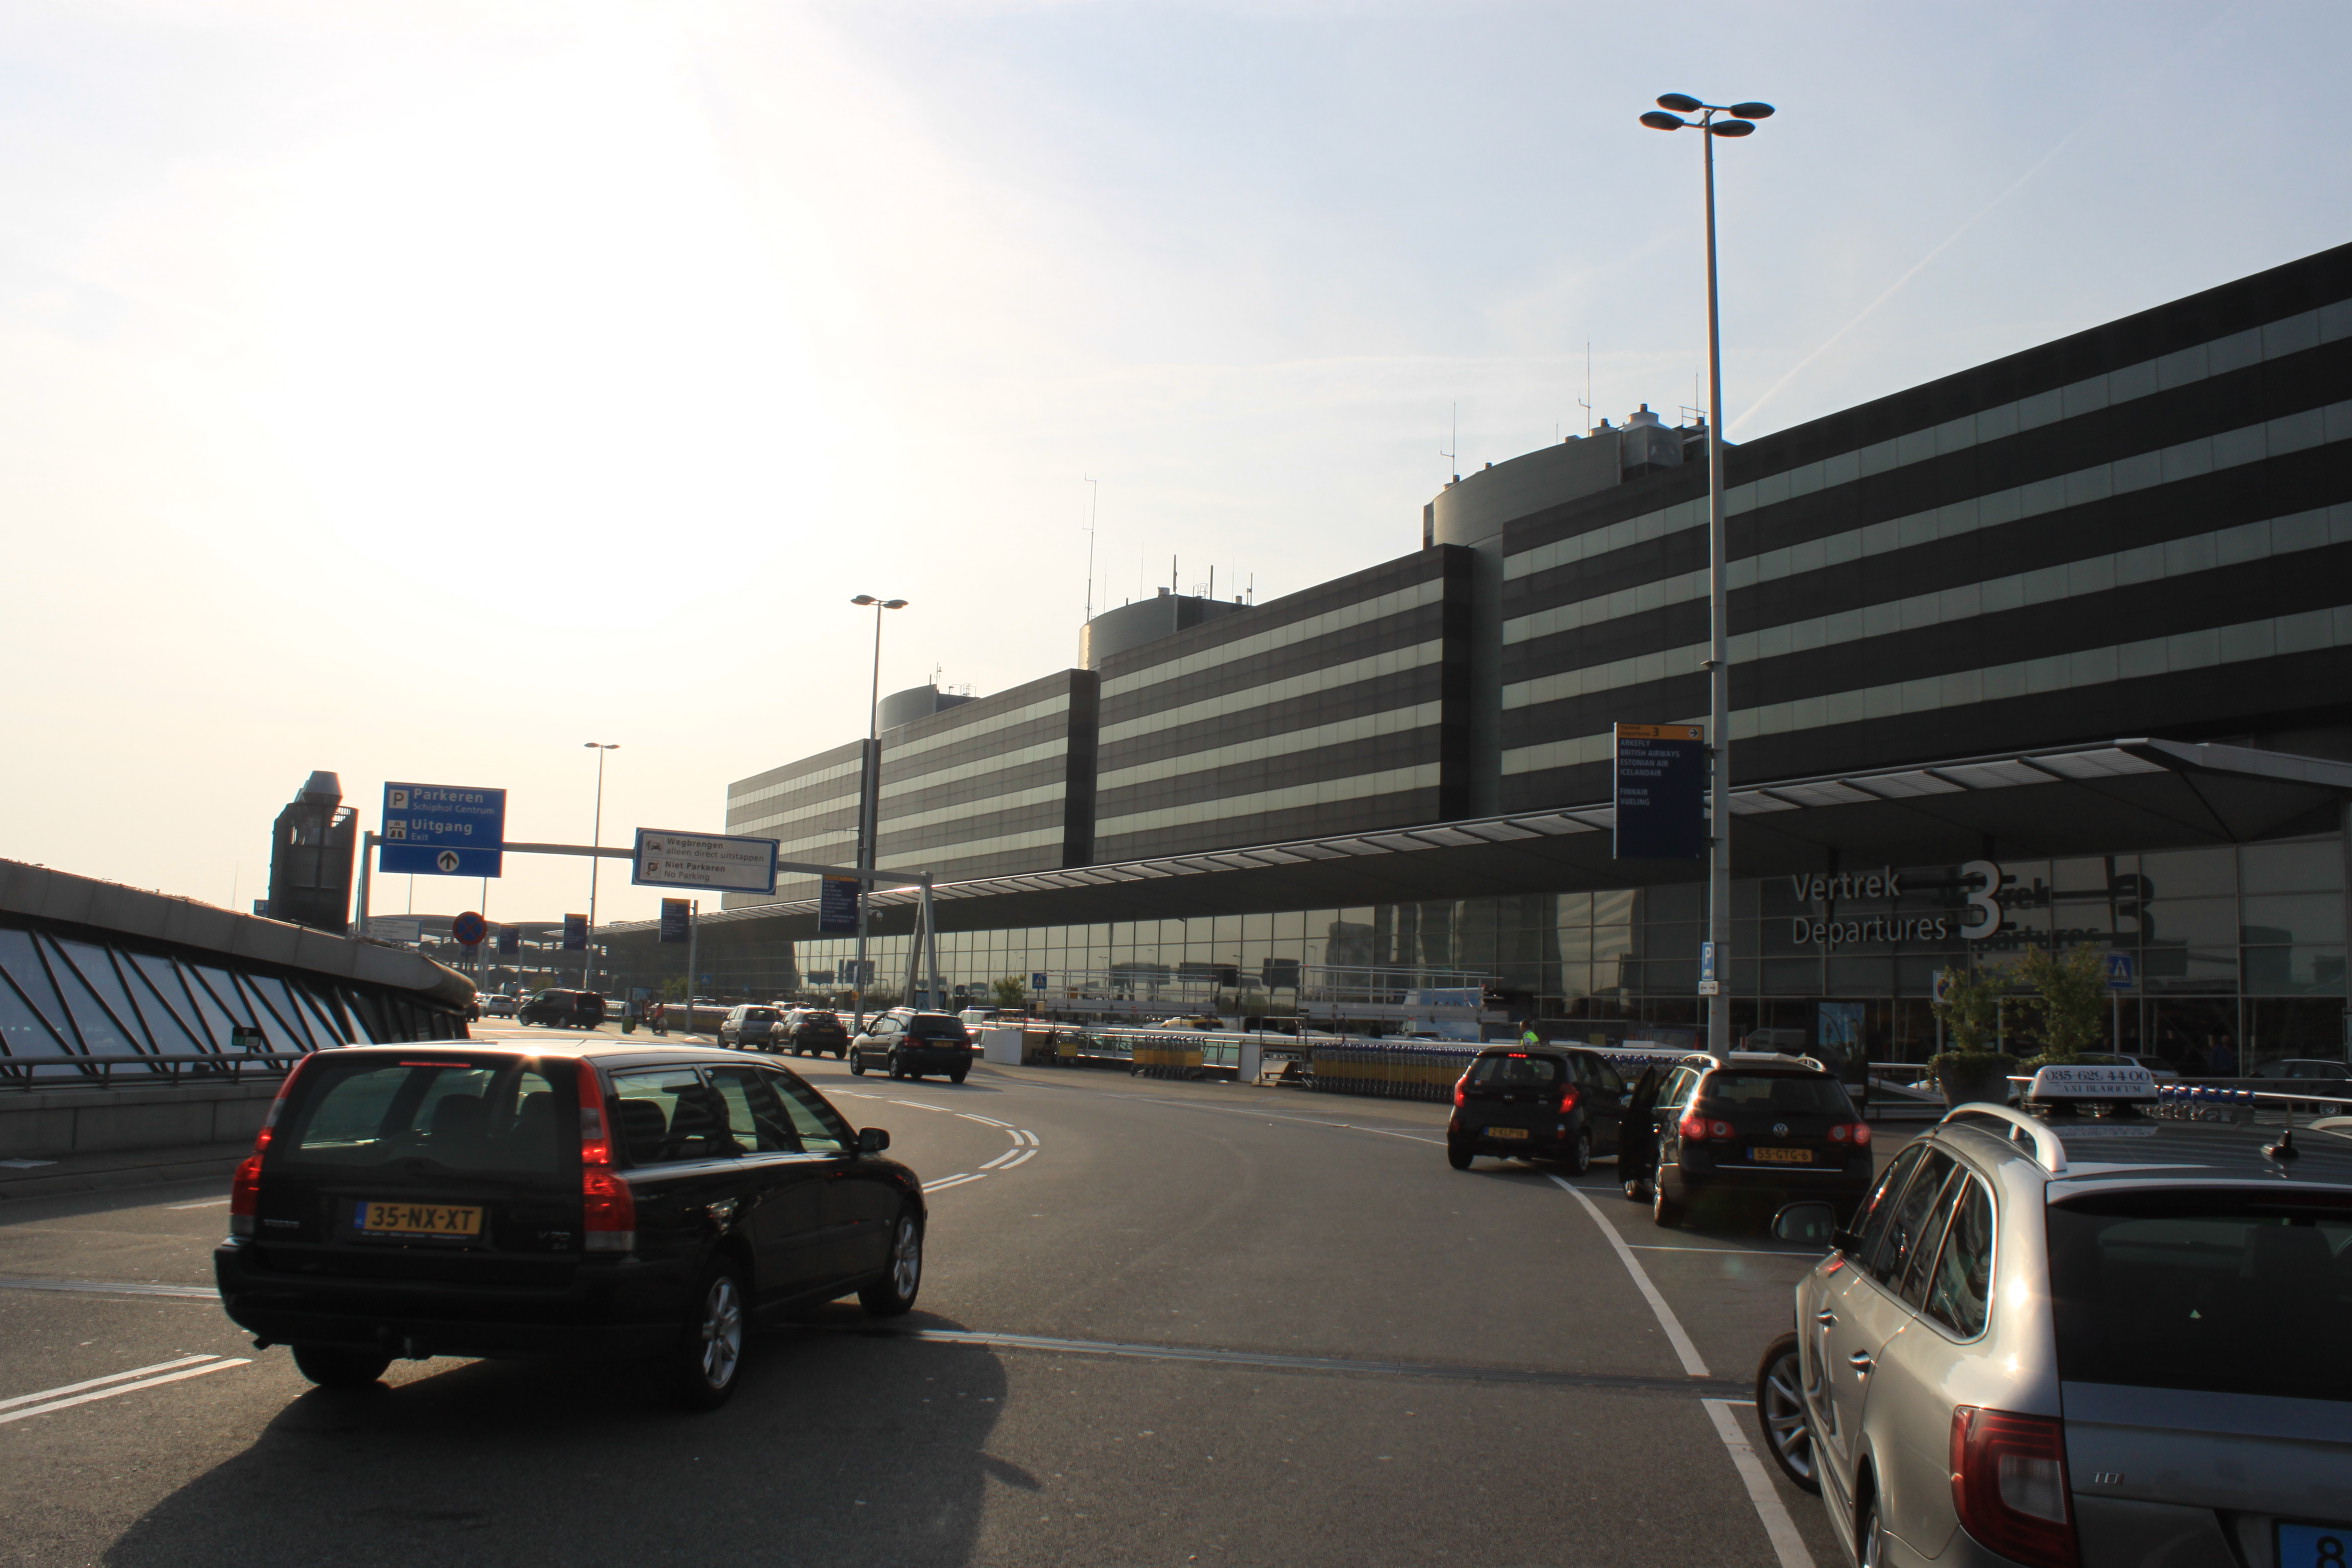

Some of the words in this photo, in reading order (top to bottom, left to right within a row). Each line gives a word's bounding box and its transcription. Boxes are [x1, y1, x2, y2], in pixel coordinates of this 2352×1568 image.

[1652, 727, 1660, 737] 3
[1648, 750, 1680, 758] AIRWAYS
[414, 789, 484, 803] Parkeren
[1620, 798, 1650, 806] VUELING
[412, 803, 452, 813] Schiphol
[455, 805, 495, 815] Centrum
[412, 818, 473, 835] Uitgang
[411, 833, 429, 841] Exit
[666, 837, 723, 849] Wegbrengen
[666, 848, 692, 856] alleen
[694, 850, 718, 858] direct
[720, 852, 764, 862] uitstappen
[665, 861, 683, 869] Niet
[686, 862, 726, 872] Parkeren
[664, 870, 676, 878] No
[678, 872, 710, 882] Parking
[1792, 865, 1901, 902] Vertrek
[1792, 916, 1948, 952] Departures
[1960, 859, 2002, 940] 3
[1758, 1148, 1808, 1160] 55-GTG-6
[372, 1206, 474, 1231] 35-NX-XT
[2092, 1472, 2125, 1485] TDI
